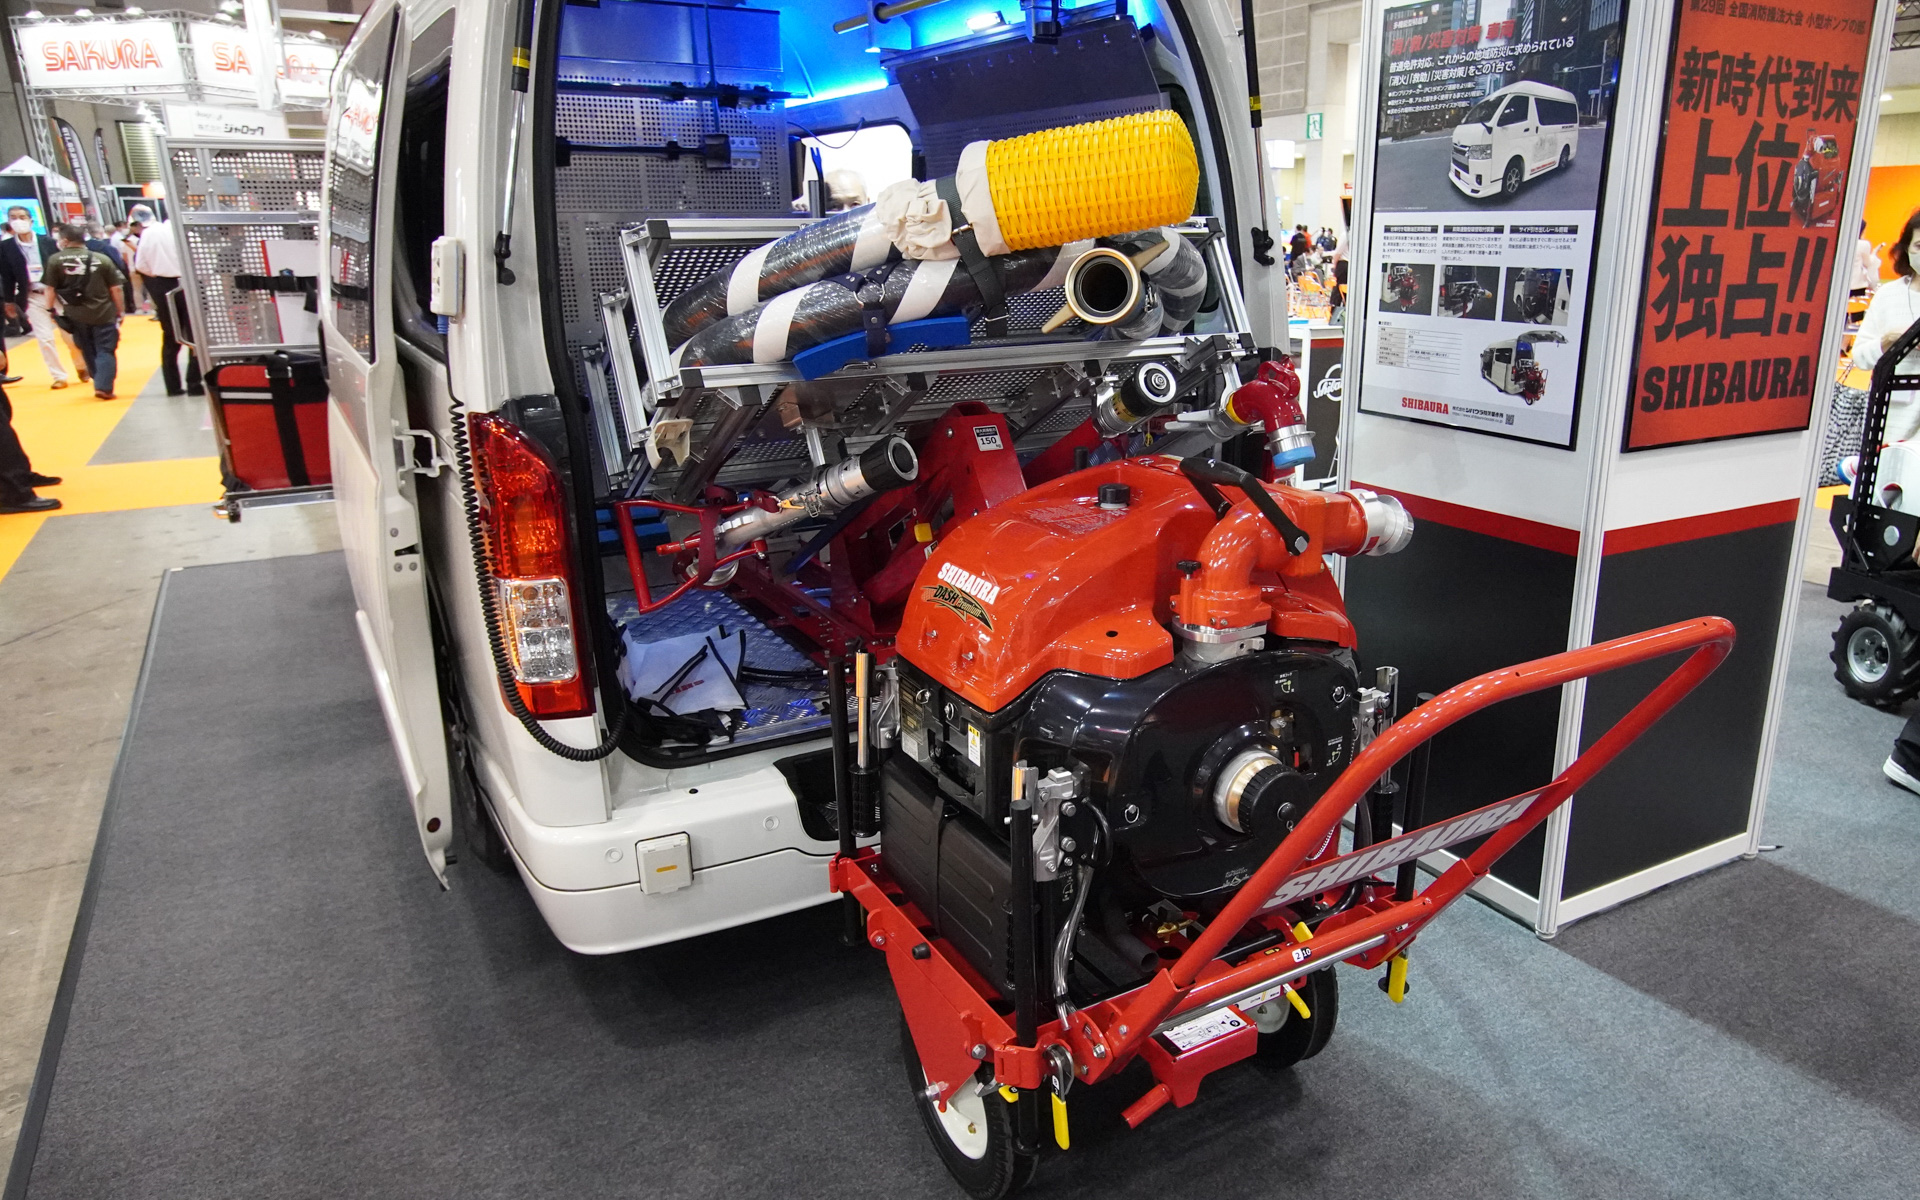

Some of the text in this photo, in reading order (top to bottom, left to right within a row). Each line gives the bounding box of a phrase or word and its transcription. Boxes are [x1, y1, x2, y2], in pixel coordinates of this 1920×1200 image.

[1806, 14, 1867, 35] 小型ポンプの部
[43, 39, 163, 71] SAKURA
[1676, 46, 1860, 123] 新時代到来
[1662, 118, 1800, 230] 上位
[1651, 234, 1829, 344] 独占!!
[1401, 397, 1449, 415] SHIBAURA
[1640, 356, 1810, 413] SHIBAURA
[980, 436, 997, 445] 150
[933, 584, 982, 617] DASH Premium
[937, 561, 1001, 605] SHIBAURA
[1262, 793, 1543, 909] SHIBAURA
